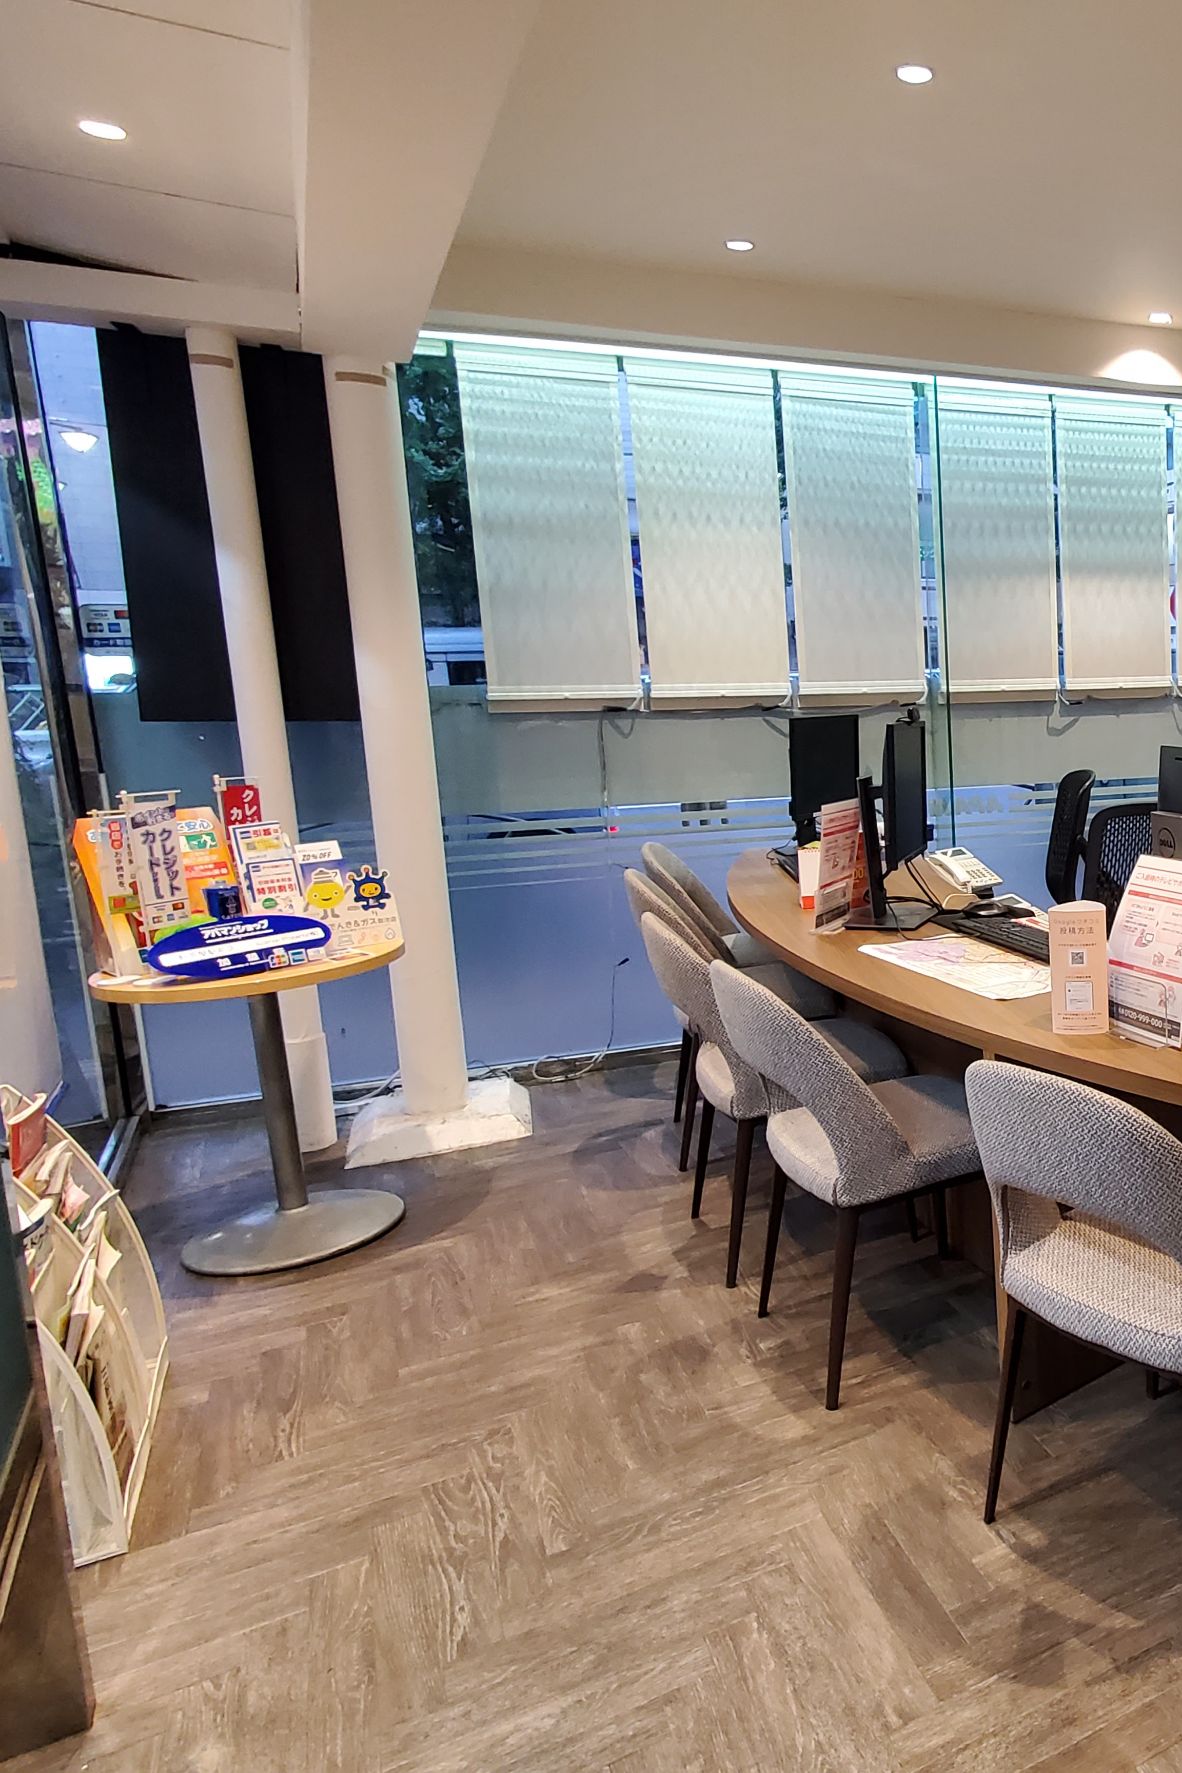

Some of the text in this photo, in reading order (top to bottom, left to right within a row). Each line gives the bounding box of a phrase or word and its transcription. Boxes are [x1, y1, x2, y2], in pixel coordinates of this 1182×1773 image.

[158, 828, 182, 897] クレジット
